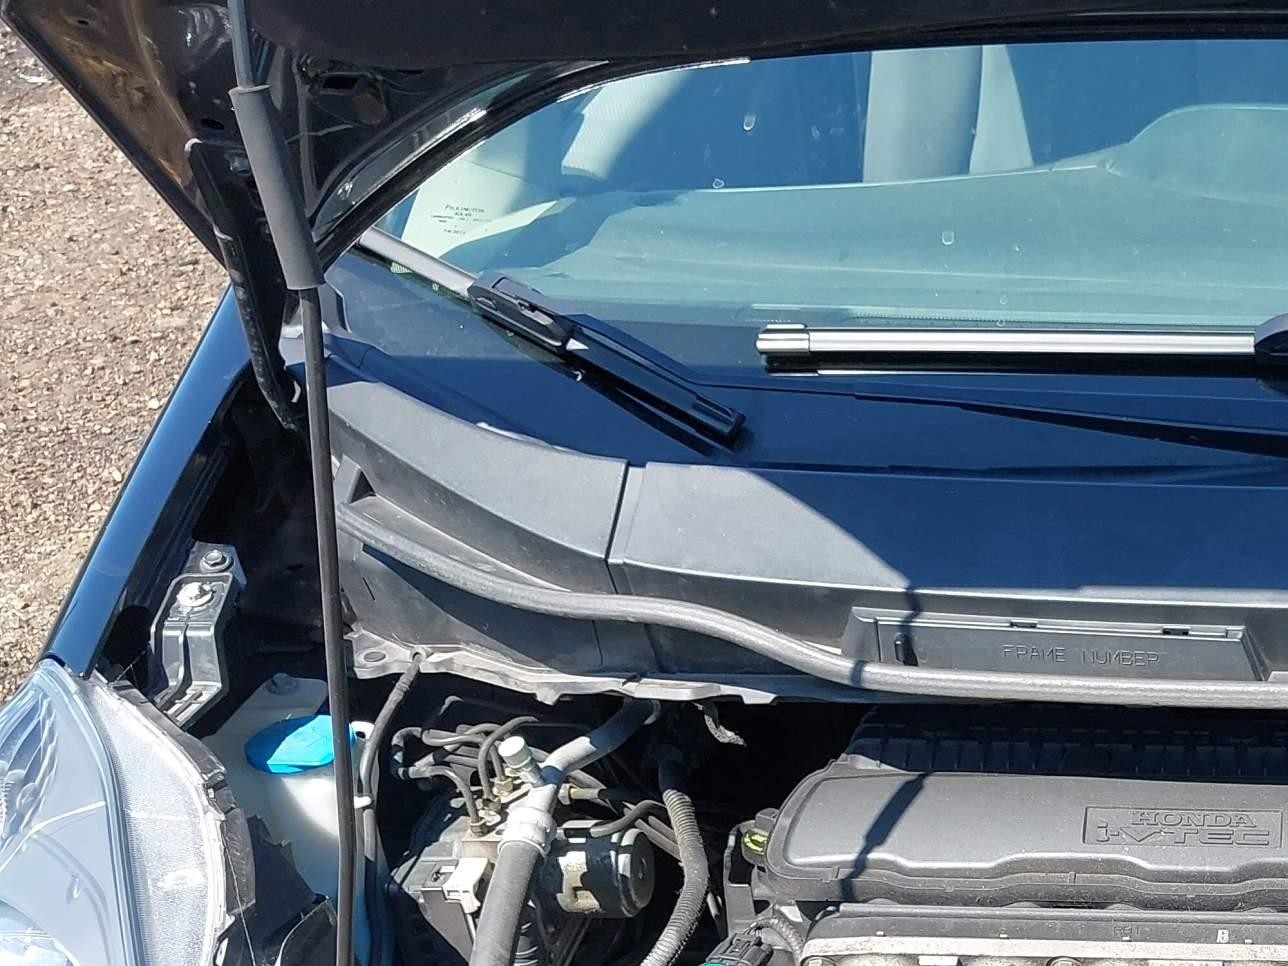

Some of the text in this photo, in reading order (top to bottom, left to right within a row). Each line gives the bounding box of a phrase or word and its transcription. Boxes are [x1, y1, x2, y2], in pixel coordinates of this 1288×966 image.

[1002, 644, 1160, 666] FRAME NUMBER
[1131, 811, 1256, 828] HONDA
[1095, 821, 1270, 846] i-VTEC
